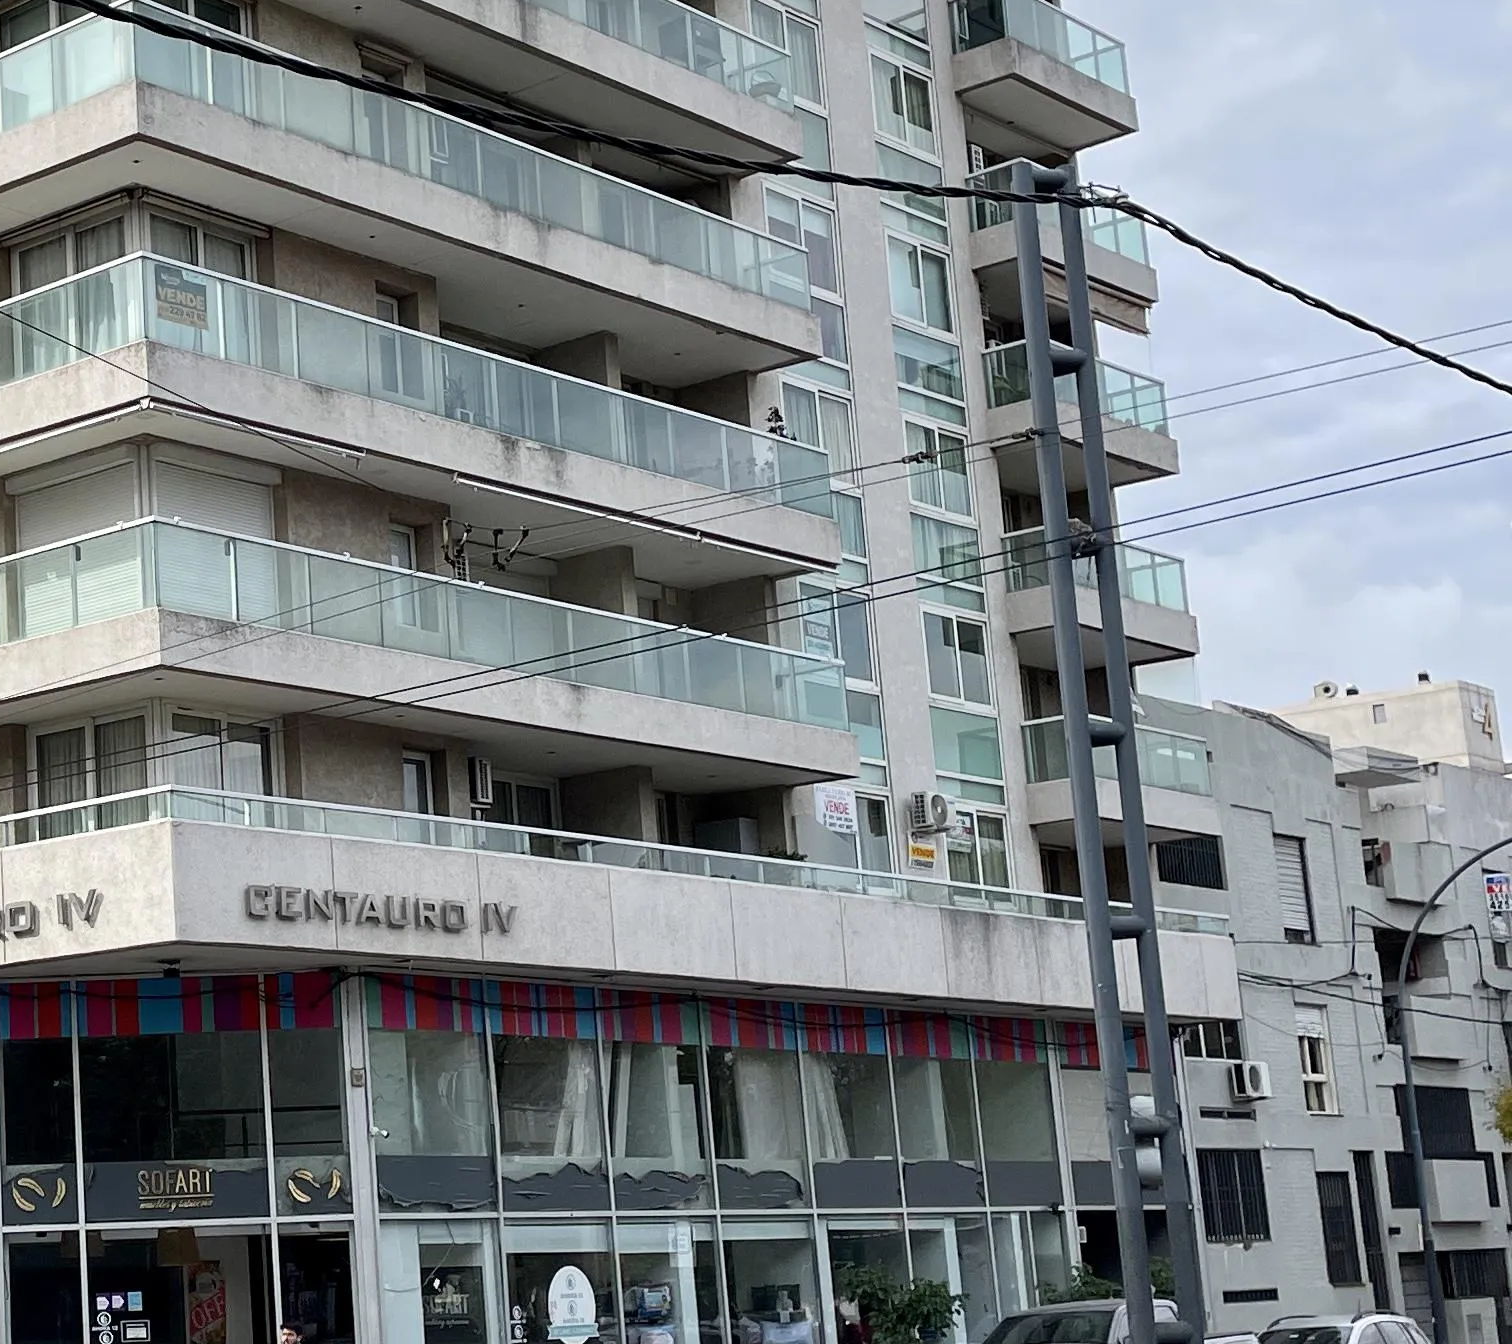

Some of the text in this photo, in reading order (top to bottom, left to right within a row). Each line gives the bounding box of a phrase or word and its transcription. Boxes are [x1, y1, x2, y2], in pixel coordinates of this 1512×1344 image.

[157, 285, 204, 310] VENDE
[56, 888, 105, 931] IV
[244, 884, 517, 935] CENTAURO IV
